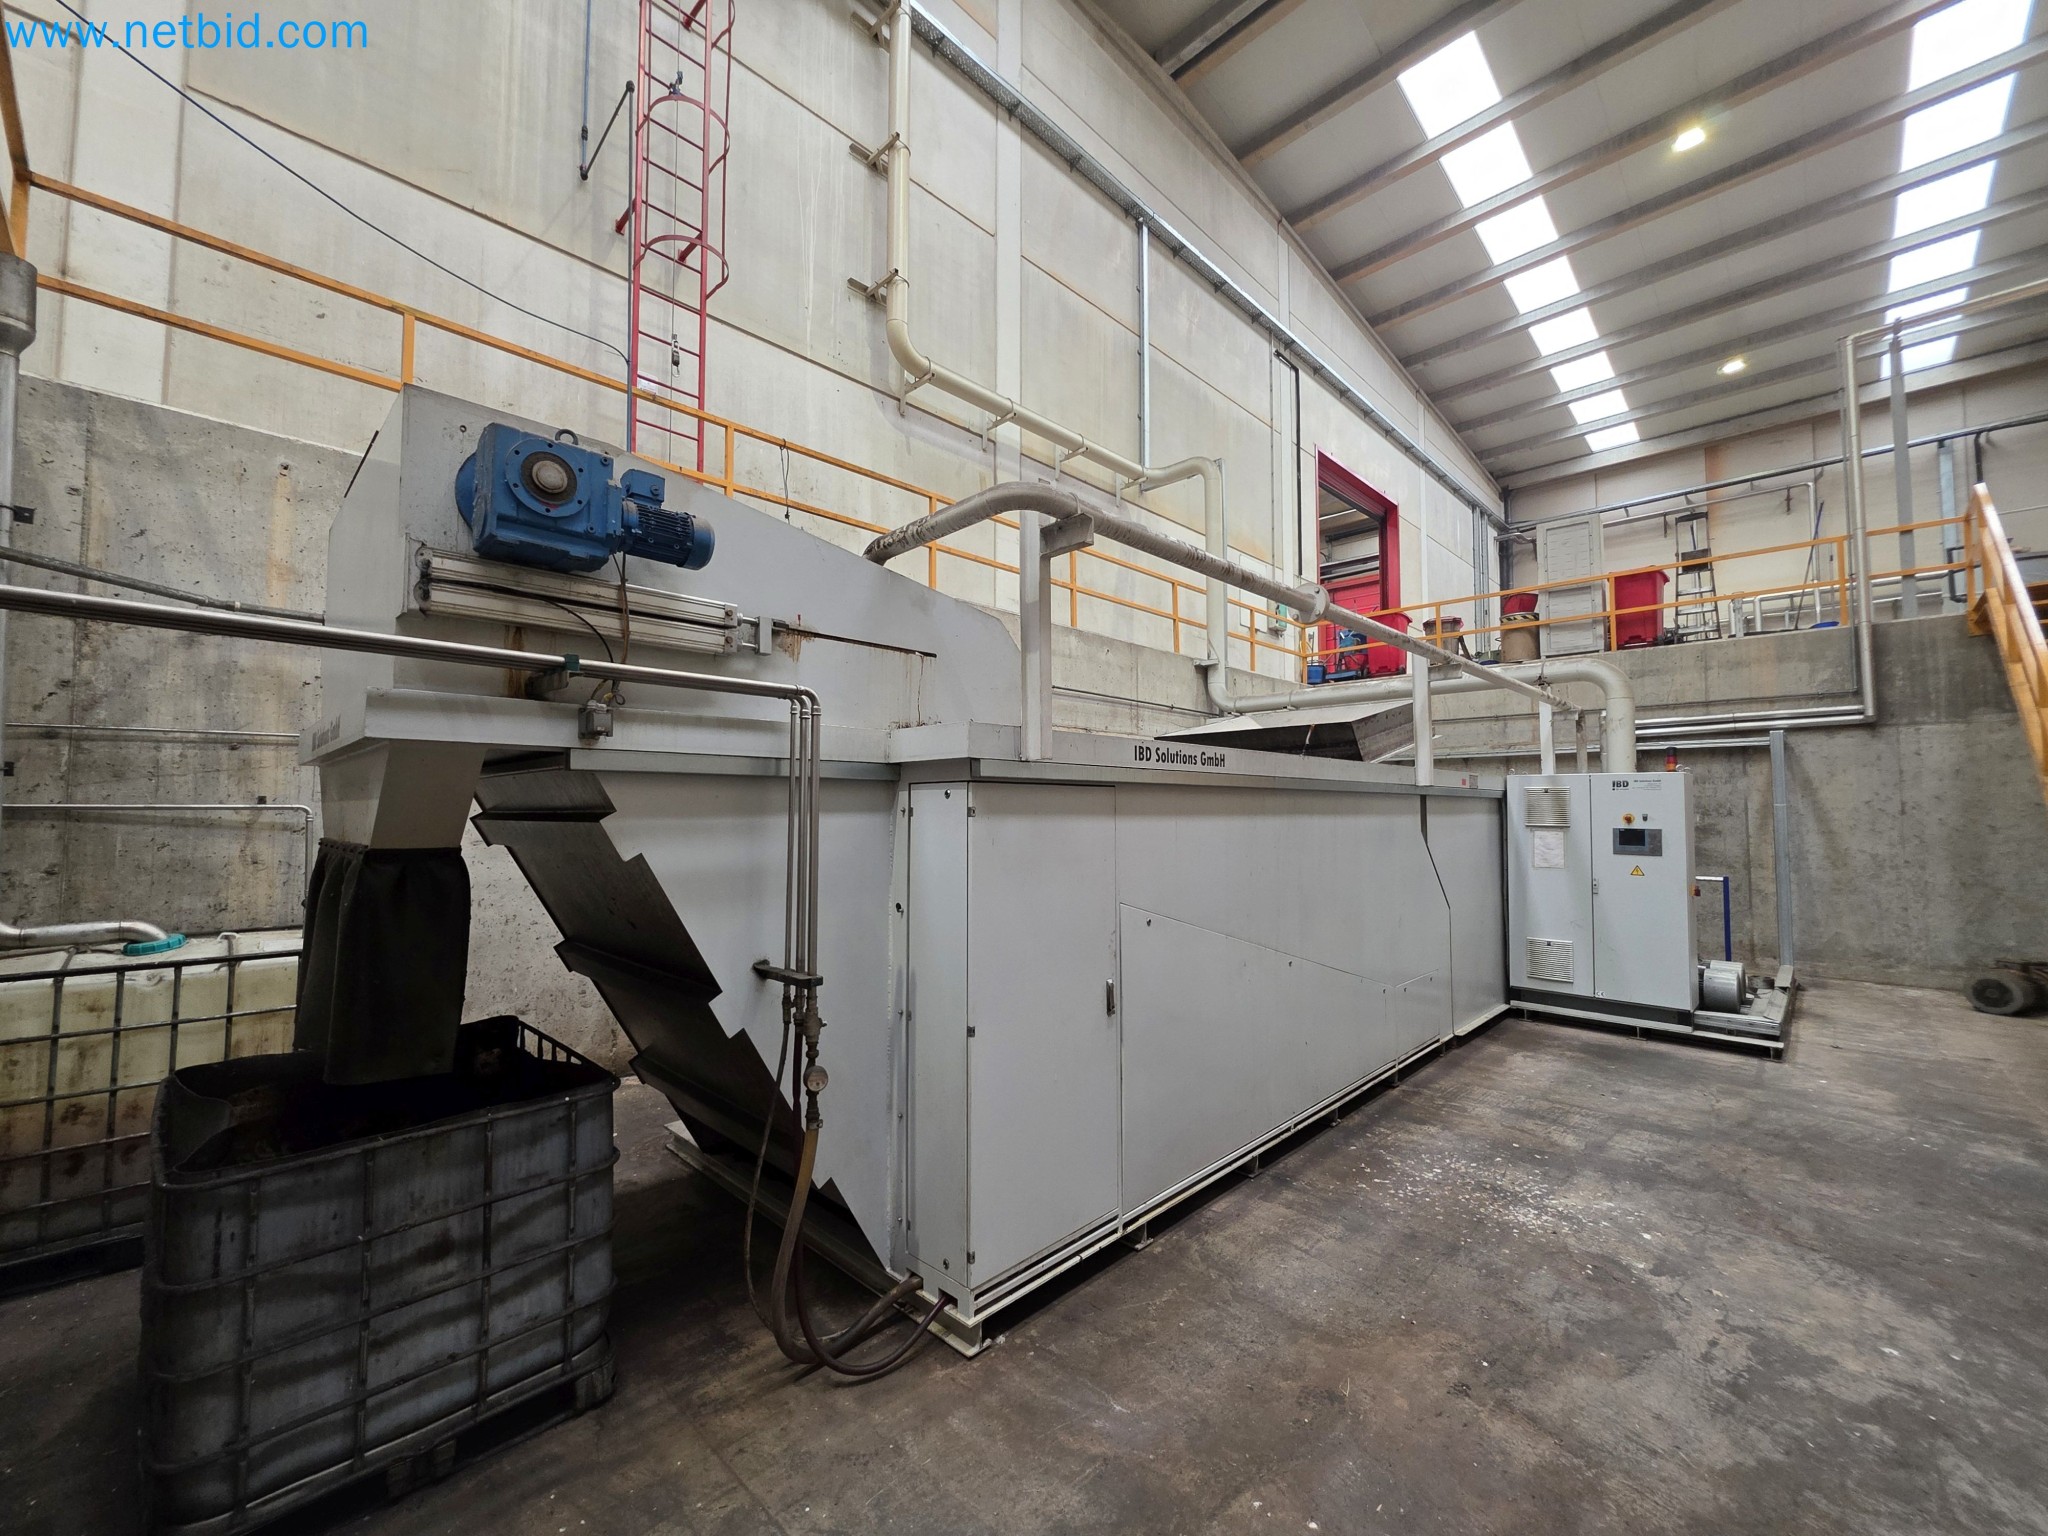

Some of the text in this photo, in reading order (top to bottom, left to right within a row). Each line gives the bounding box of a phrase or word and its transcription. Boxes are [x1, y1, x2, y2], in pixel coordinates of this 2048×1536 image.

[1134, 745, 1226, 768] IBD Solutions GmbH
